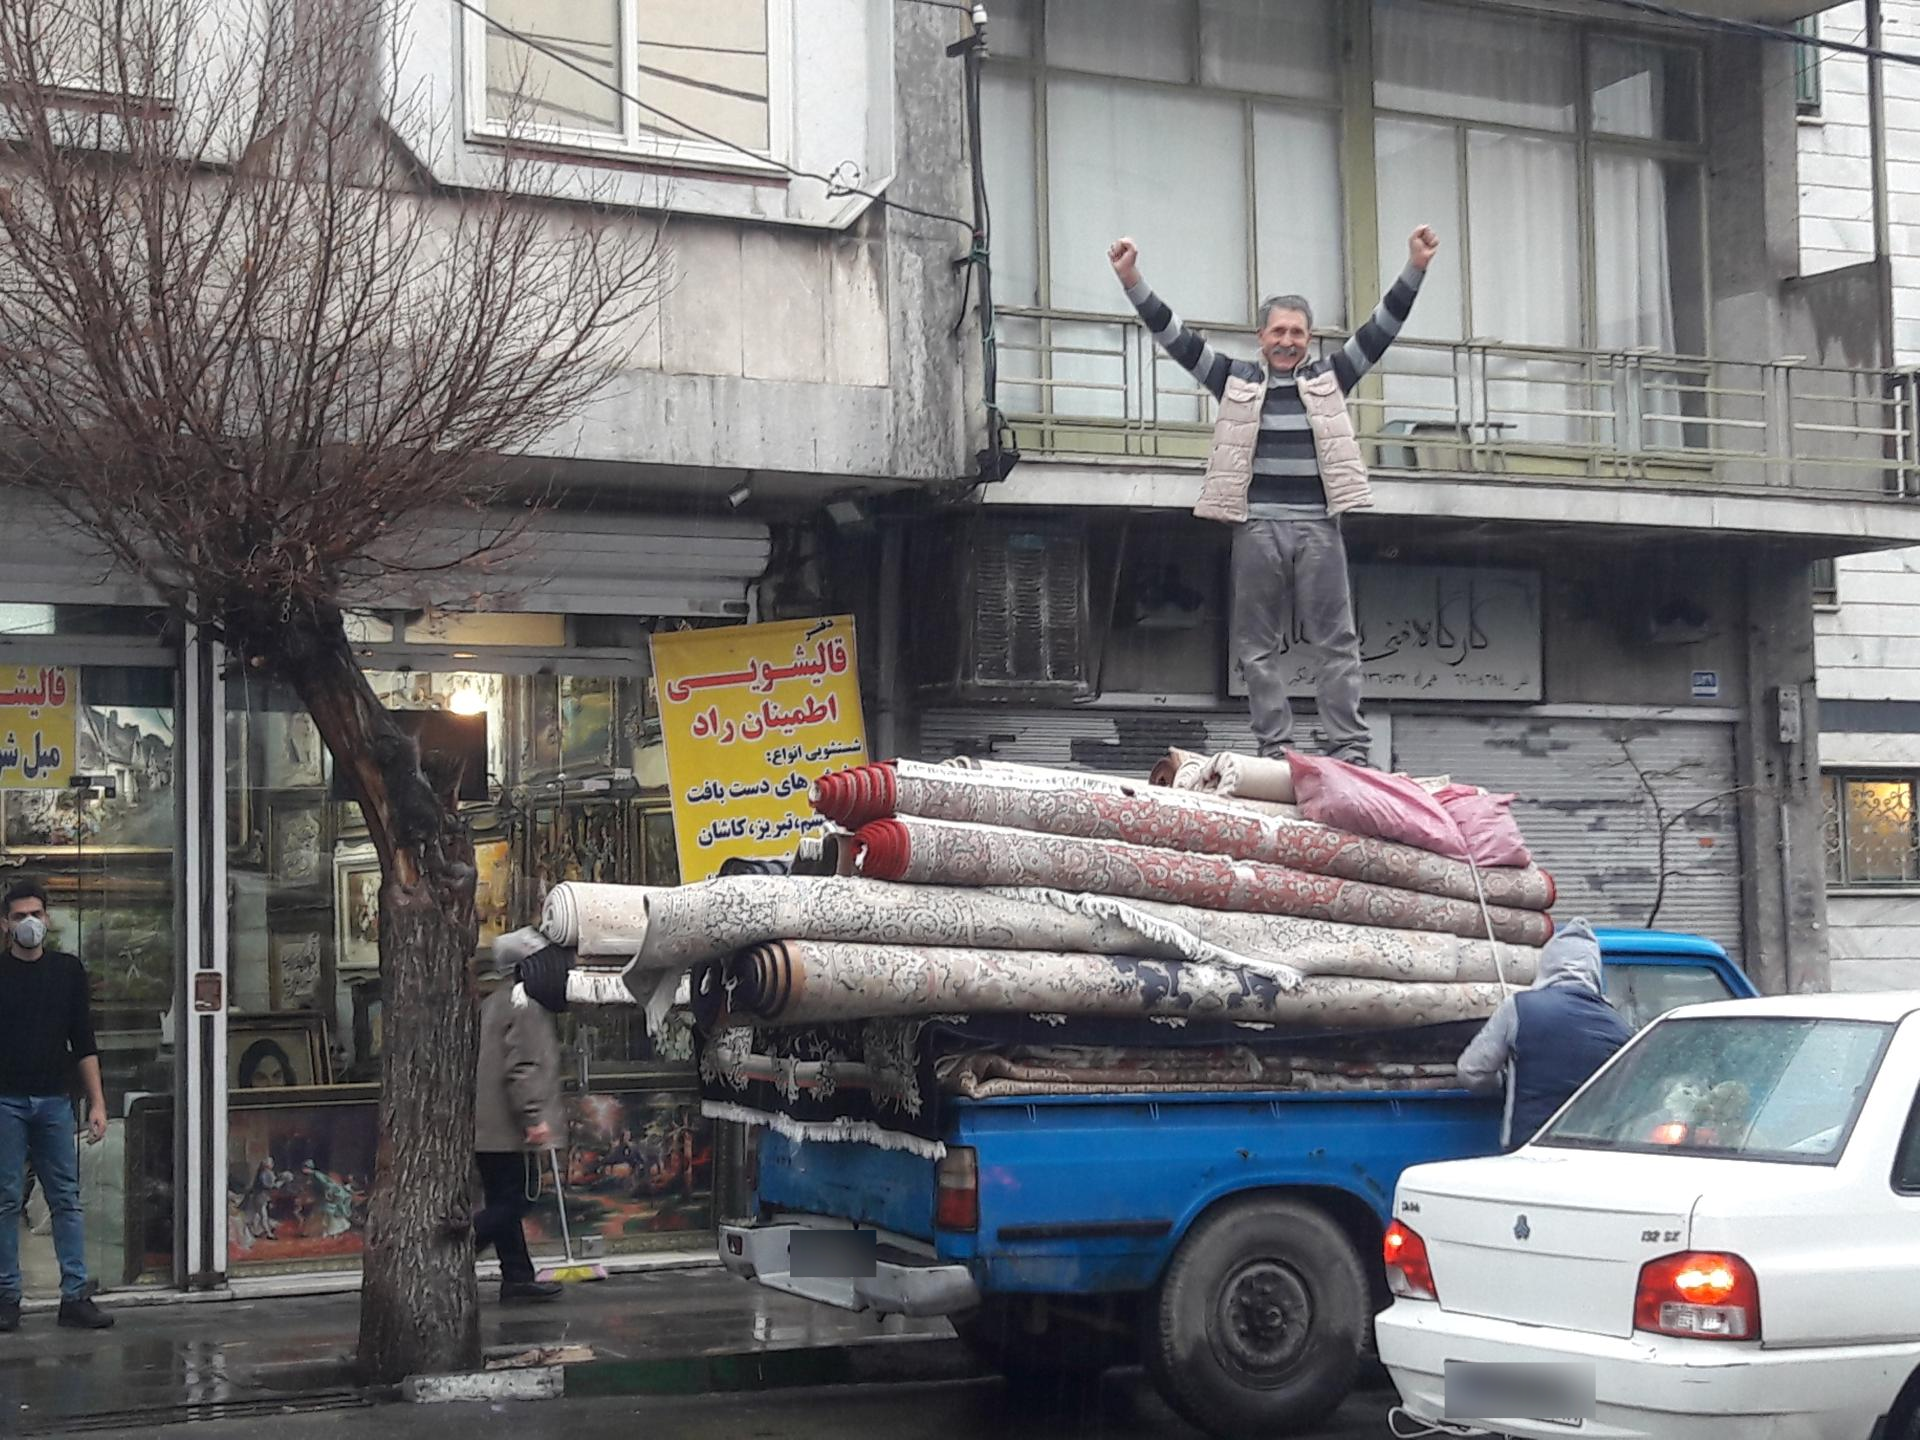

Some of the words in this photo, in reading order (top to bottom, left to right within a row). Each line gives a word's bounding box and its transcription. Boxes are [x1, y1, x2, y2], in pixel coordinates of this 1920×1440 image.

[666, 639, 847, 701] قالیشویی
[693, 707, 734, 743] راد
[742, 694, 837, 739] اطمینان
[24, 732, 60, 778] مبل
[687, 782, 725, 804] بافت
[729, 780, 770, 798] دست
[775, 772, 807, 797] های
